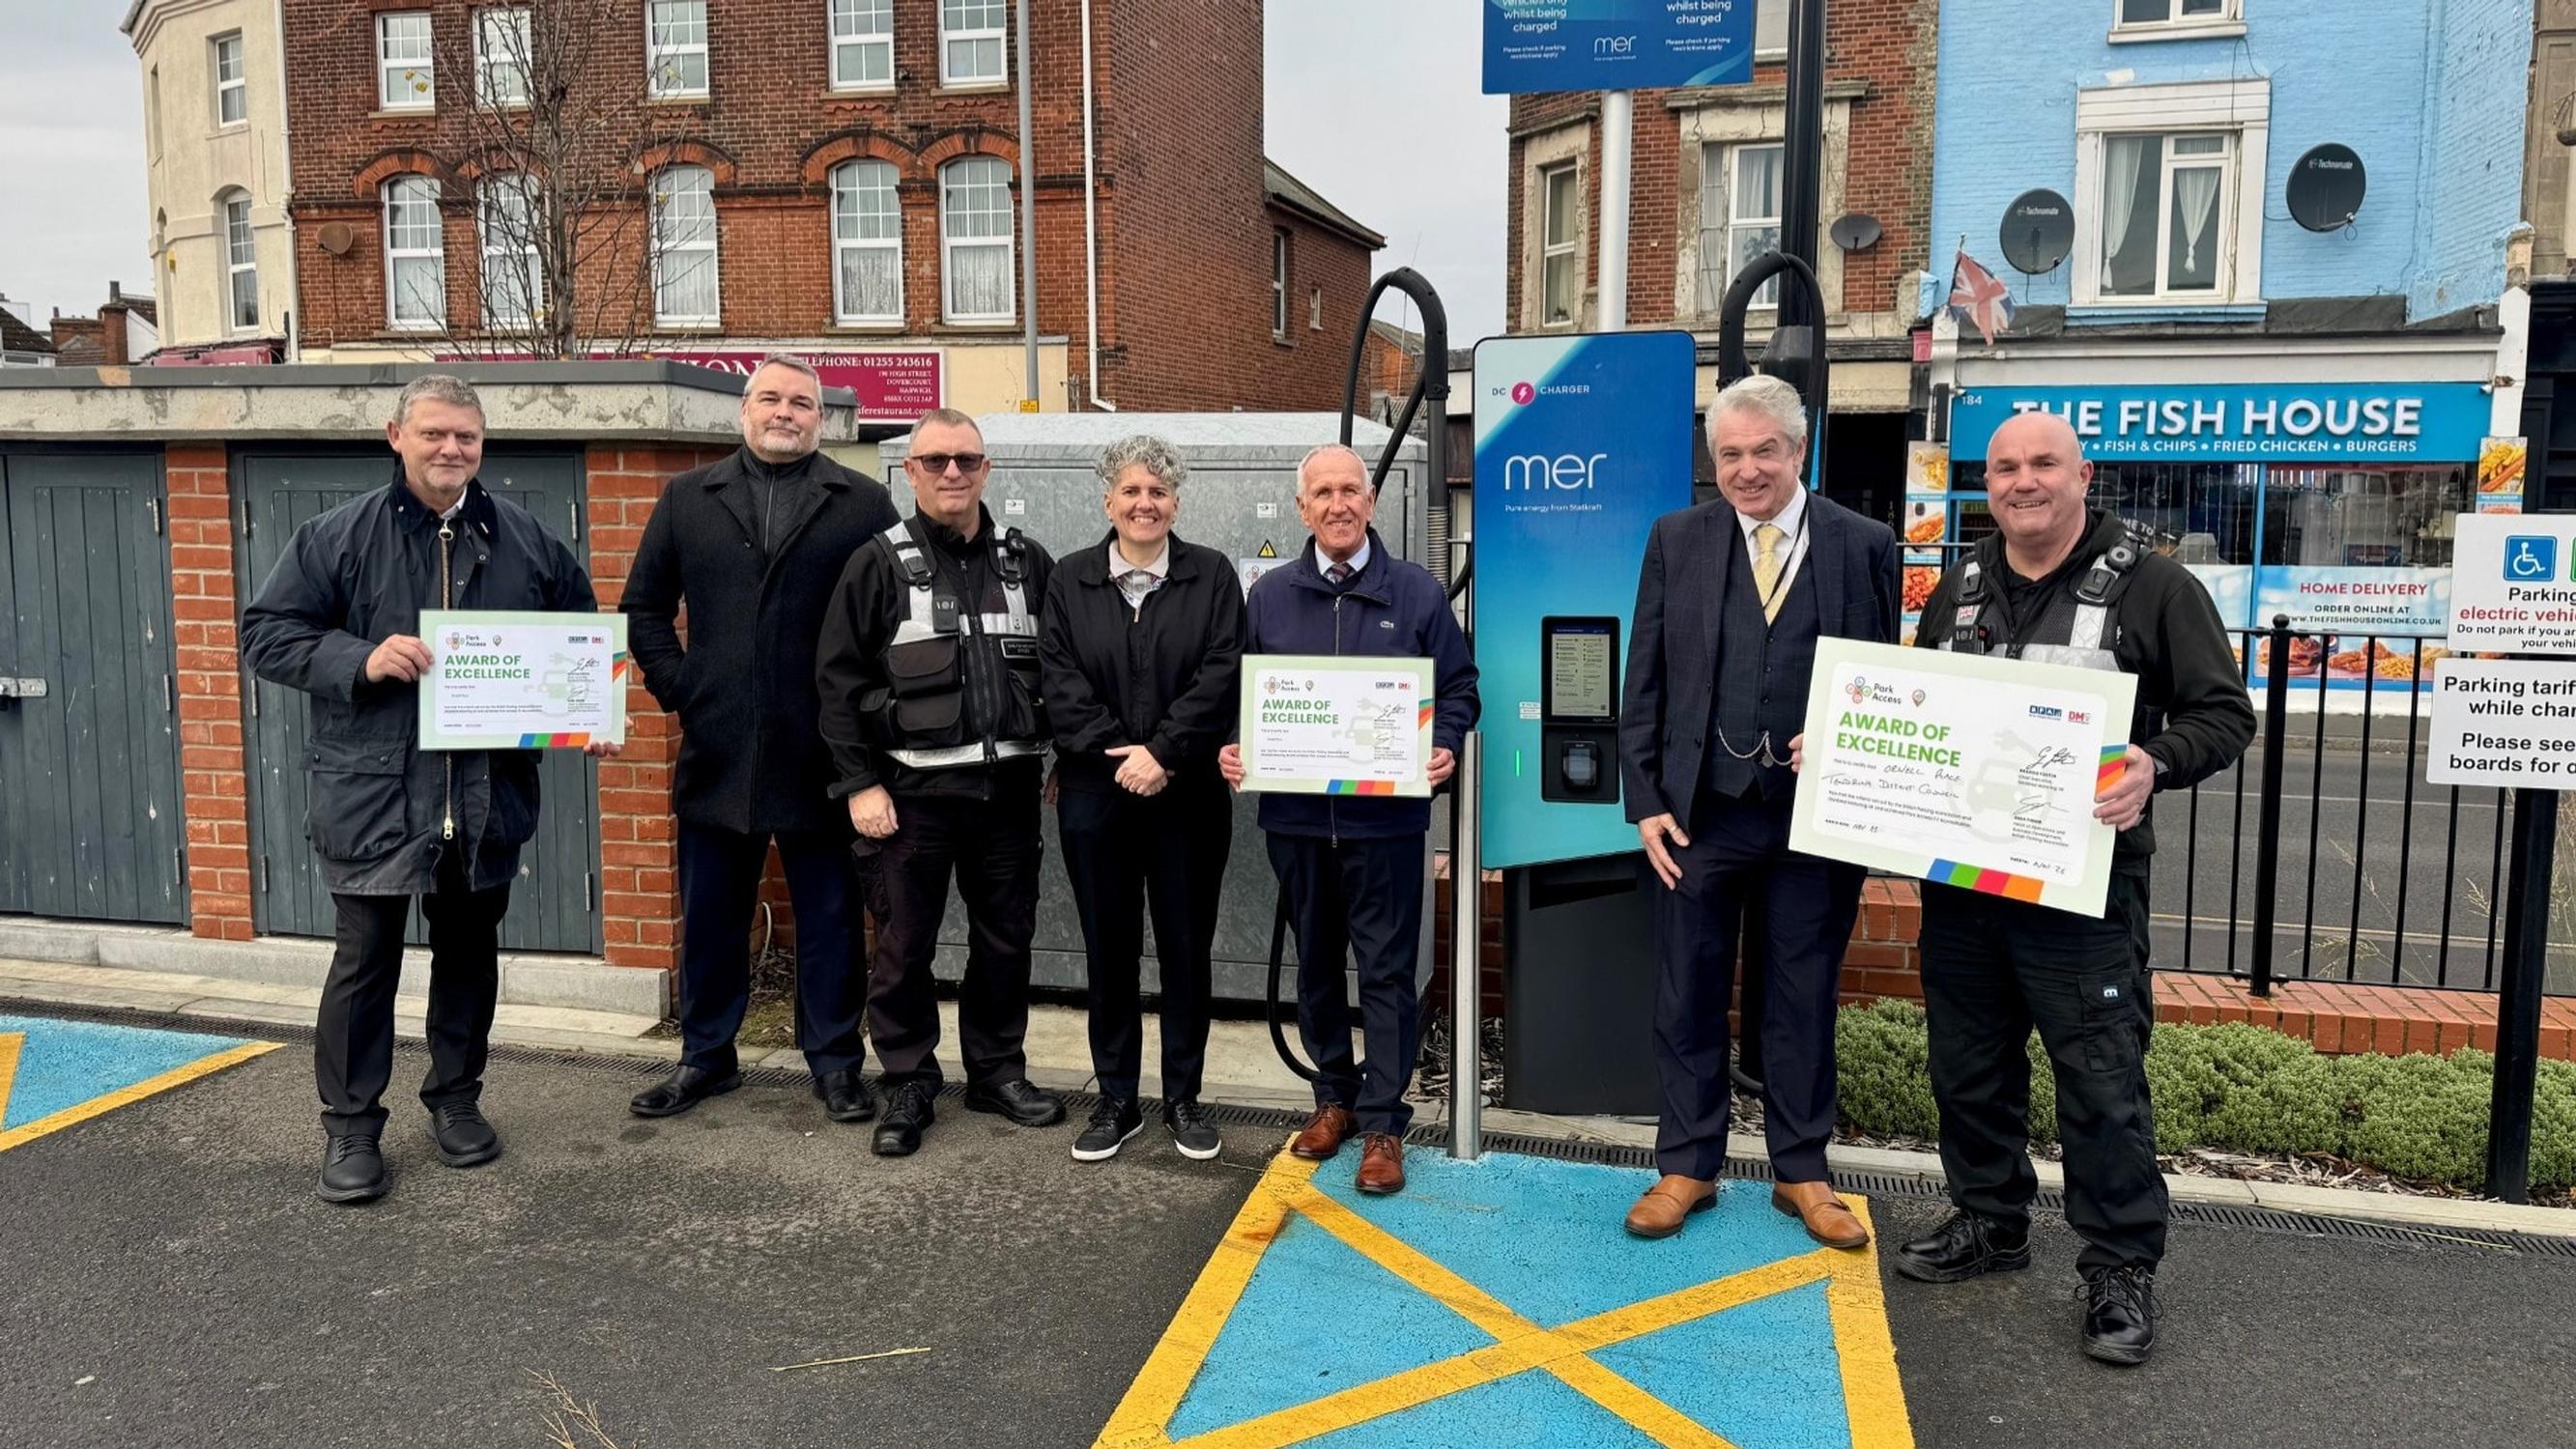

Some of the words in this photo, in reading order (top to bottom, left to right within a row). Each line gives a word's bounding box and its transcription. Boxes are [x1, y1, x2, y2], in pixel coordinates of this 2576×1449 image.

[1667, 1, 1698, 12] whilst
[1701, 0, 1732, 11] being
[1503, 9, 1534, 19] whilst
[1537, 8, 1567, 18] being
[1675, 12, 1722, 25] charged
[1512, 20, 1558, 33] charged
[1594, 35, 1637, 53] mer
[803, 356, 862, 367] LEPHONE:
[863, 356, 894, 367] 01255
[896, 356, 932, 367] 243616
[1492, 387, 1506, 396] DC
[1540, 384, 1590, 395] CHARGER
[1962, 395, 1983, 406] 184
[2119, 398, 2226, 436] FISH
[2242, 398, 2423, 437] HOUSE
[2104, 440, 2135, 452] FISH
[2139, 440, 2150, 452] &
[2153, 440, 2196, 452] CHIPS
[2213, 440, 2257, 452] FRIED
[2260, 440, 2329, 452] CHICKEN
[2346, 440, 2418, 452] BURGERS
[1504, 453, 1608, 491] mer
[2300, 582, 2348, 595] HOME
[2352, 582, 2428, 596] DELIVERY
[2508, 587, 2576, 607] Parking
[2314, 605, 2350, 613] ORDER
[2354, 605, 2394, 614] ONLINE
[2396, 606, 2411, 614] AT
[2459, 606, 2530, 621] electric
[2534, 607, 2576, 622] vehi
[2289, 615, 2442, 626] WW.THEFISHHOUSEONLINE.CO.UK
[2457, 624, 2473, 634] Do
[2476, 625, 2495, 634] not
[2499, 625, 2525, 636] park
[2528, 625, 2536, 635] if
[2538, 627, 2561, 638] you
[2521, 639, 2549, 649] your
[444, 655, 500, 666] AWARD
[502, 655, 522, 666] OF
[444, 668, 530, 679] EXCELLENCE
[1873, 683, 1894, 694] Park
[2444, 676, 2526, 697] Parking
[1872, 693, 1902, 704] Access
[1262, 699, 1311, 710] AWARD
[1314, 700, 1331, 711] OF
[2469, 699, 2525, 716] while
[1262, 712, 1339, 724] EXCELLENCE
[1839, 711, 1918, 737] AWARD
[1922, 724, 1951, 742] OF
[2461, 732, 2533, 751] Please
[2538, 739, 2576, 752] see
[1836, 731, 1961, 768] EXCELLENCE
[2449, 753, 2523, 772] boards
[2530, 756, 2562, 773] for
